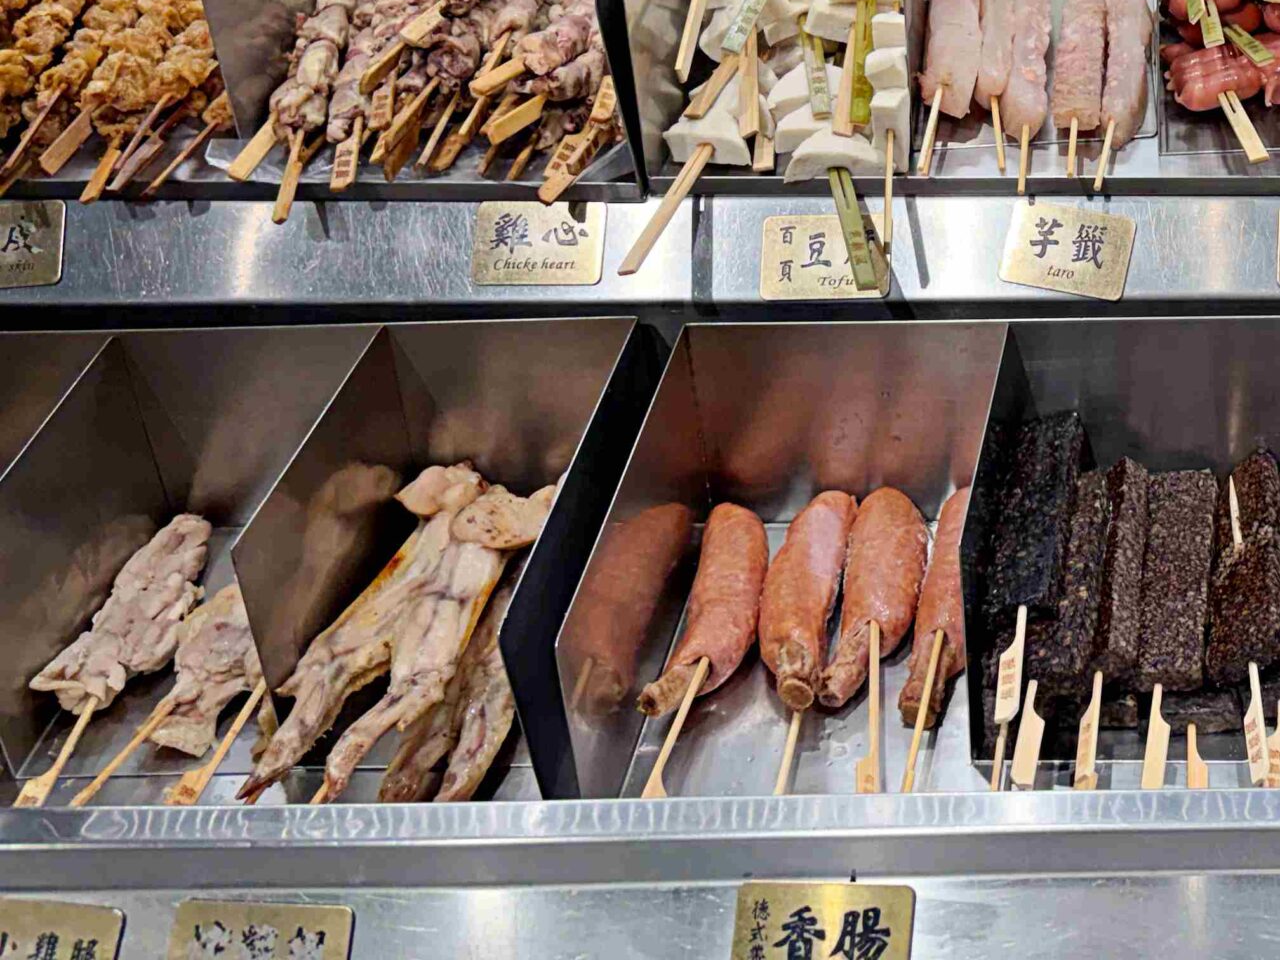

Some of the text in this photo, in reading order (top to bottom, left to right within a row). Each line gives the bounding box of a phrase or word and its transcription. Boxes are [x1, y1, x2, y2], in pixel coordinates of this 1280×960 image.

[489, 212, 589, 254] 雞心
[1028, 216, 1108, 270] 芋籤
[540, 256, 577, 271] heart
[1046, 264, 1076, 280] taro
[773, 904, 891, 960] 香腸
